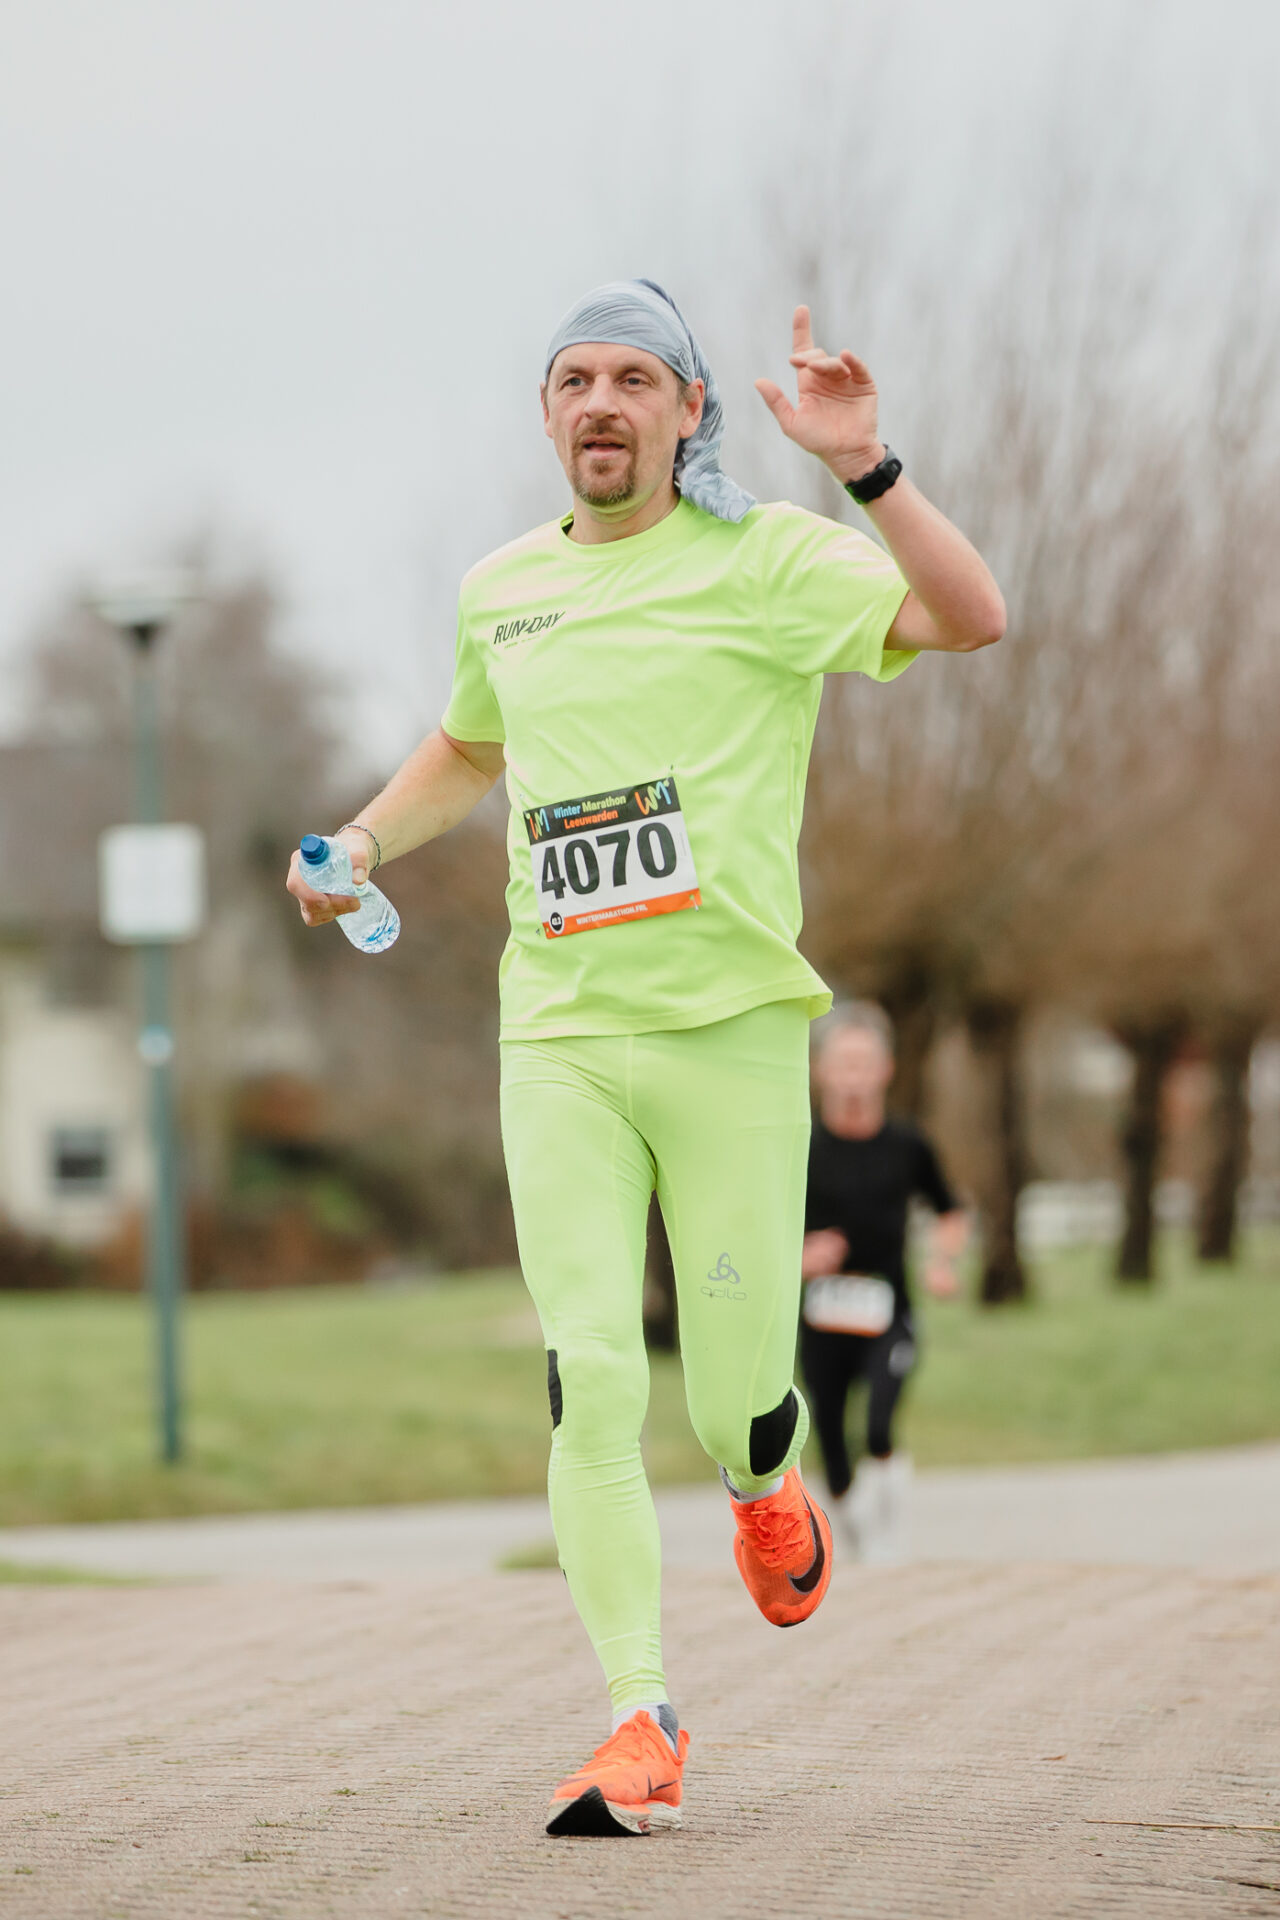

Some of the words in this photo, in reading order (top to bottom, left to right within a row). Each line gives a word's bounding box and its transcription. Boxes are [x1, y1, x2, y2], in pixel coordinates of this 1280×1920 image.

[554, 805, 581, 819] Winter
[582, 795, 626, 811] Marathon
[564, 810, 618, 829] Leeuwarden
[541, 822, 677, 900] 4070
